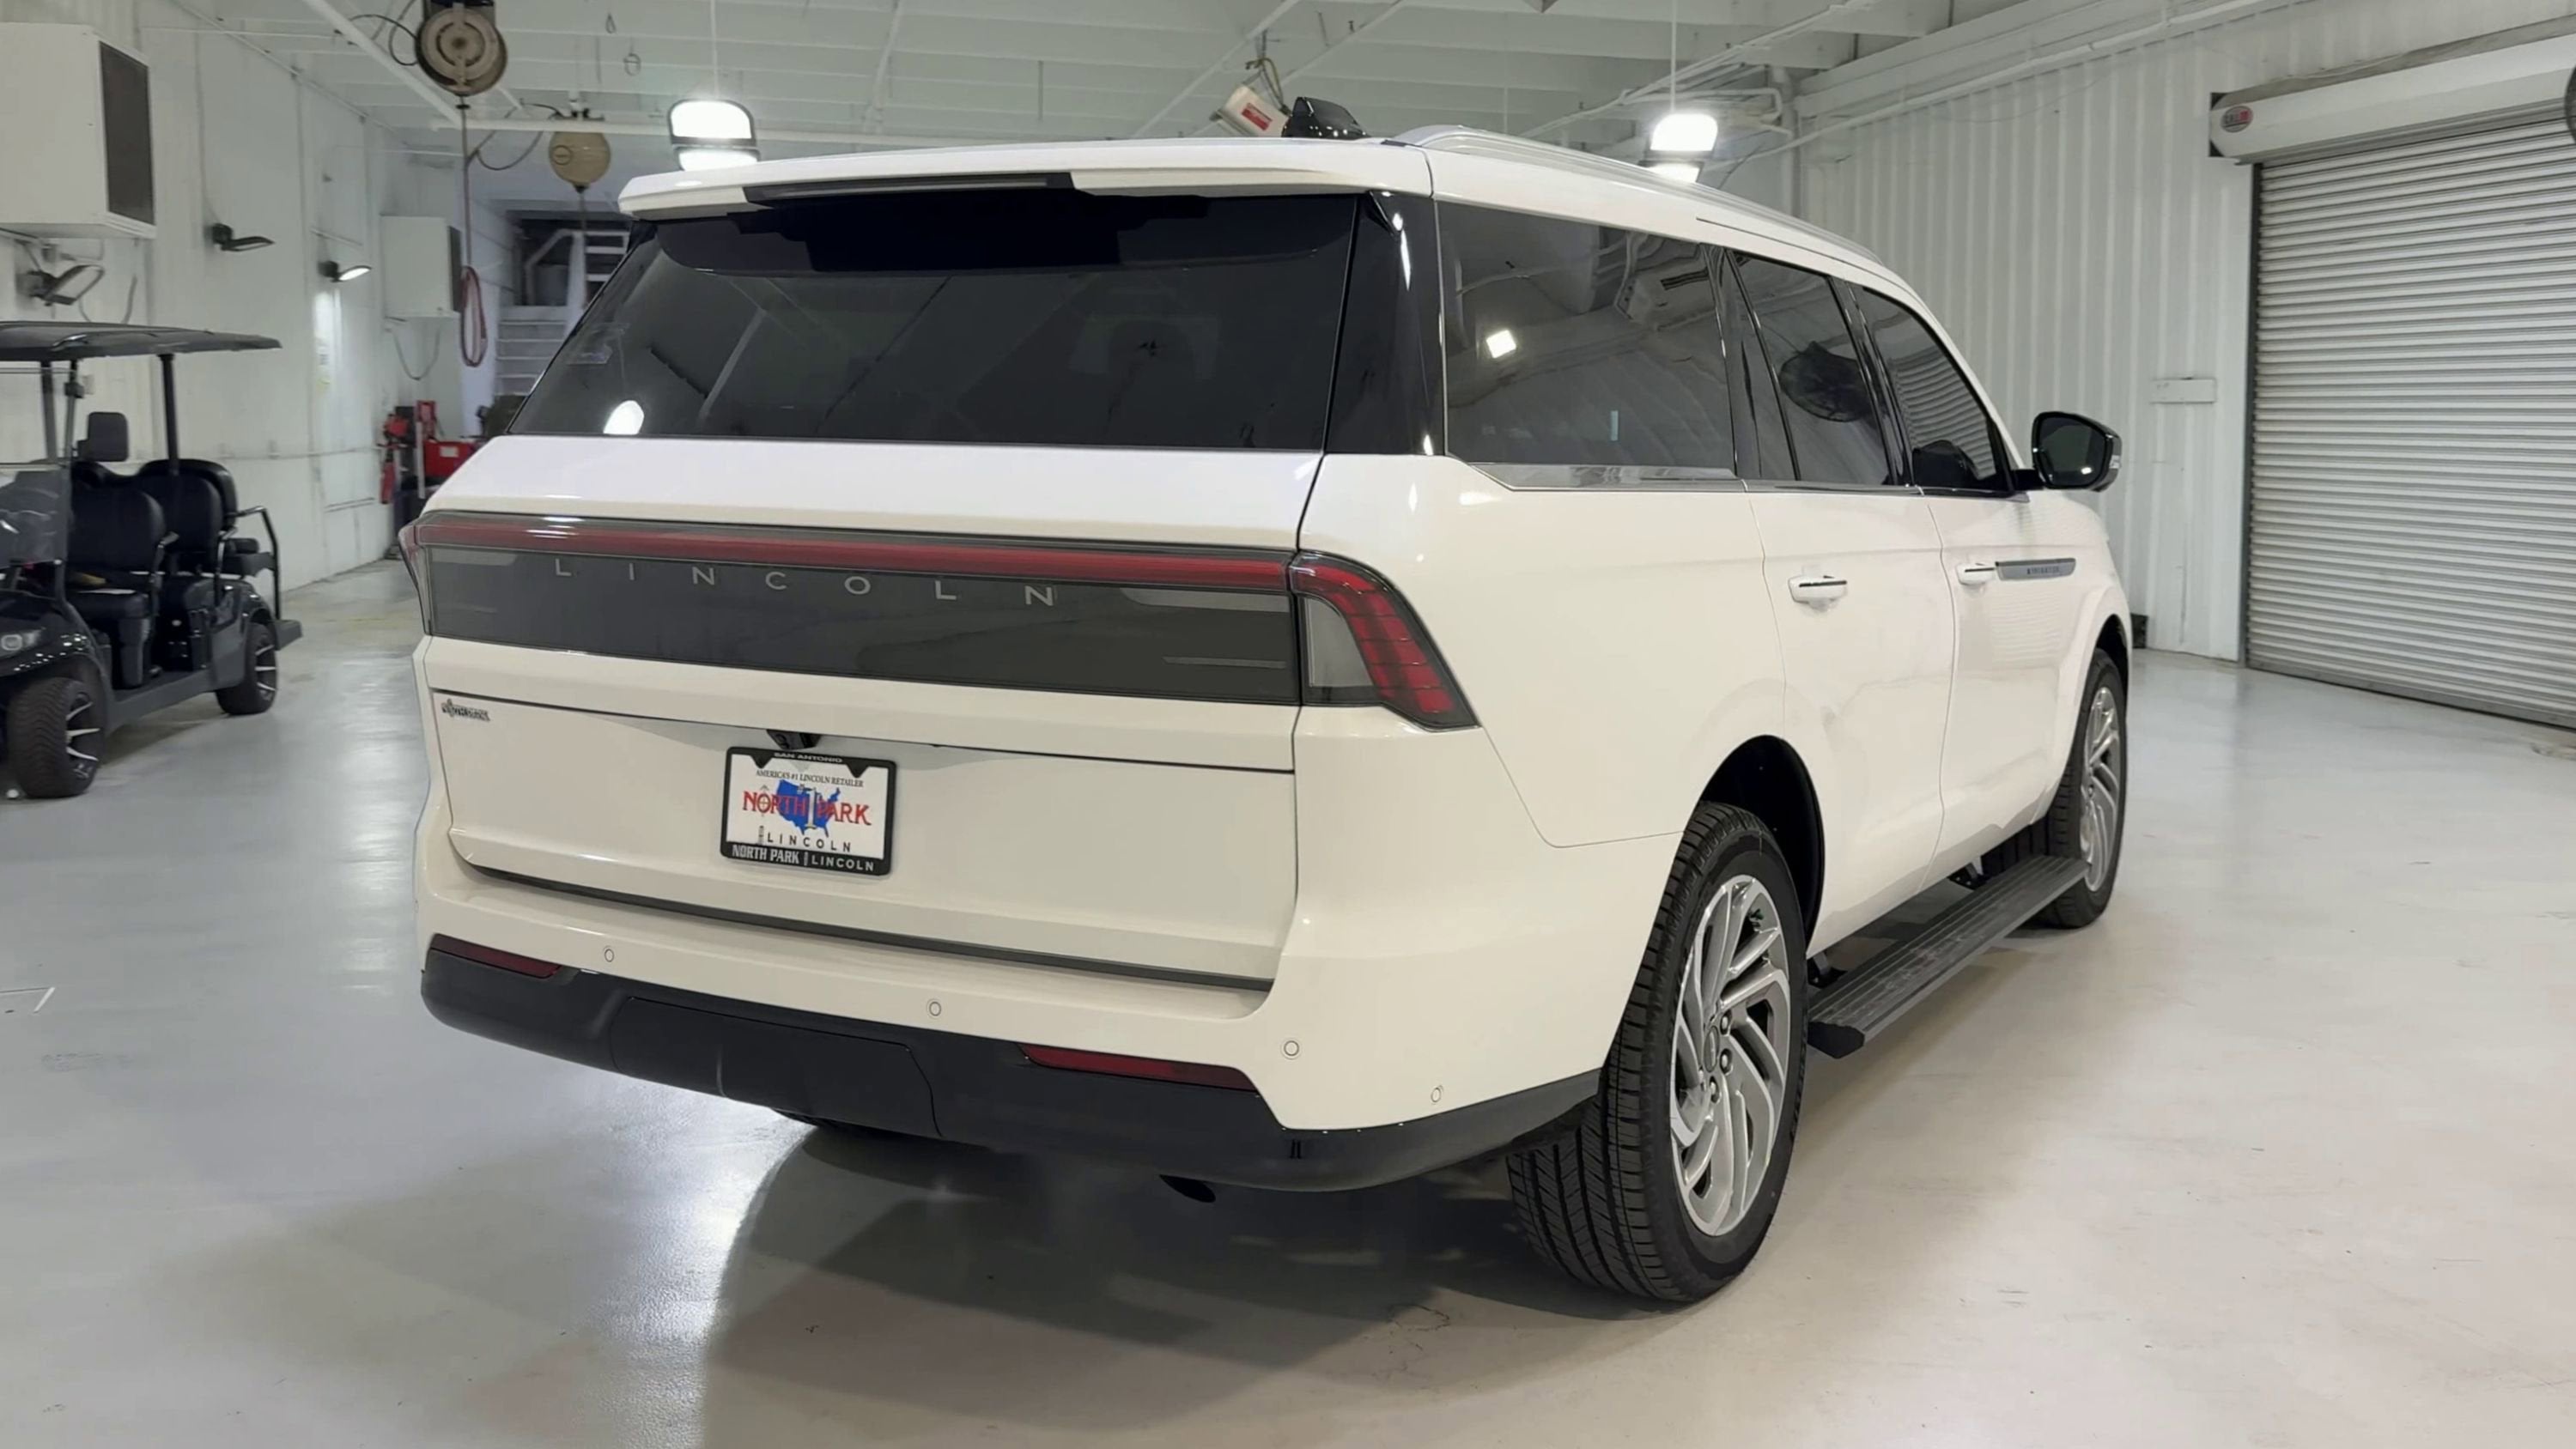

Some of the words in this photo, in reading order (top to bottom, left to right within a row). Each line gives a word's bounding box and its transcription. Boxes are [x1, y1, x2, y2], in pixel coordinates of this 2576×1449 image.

[555, 558, 1054, 607] LINCOLN
[798, 755, 843, 763] ANTONIO
[799, 773, 830, 785] LINCOLN
[831, 777, 864, 787] RETAILER
[742, 791, 807, 816] NORTH
[817, 797, 872, 826] PARK
[768, 832, 851, 852] LINCOLN
[732, 845, 767, 861] NORTH
[770, 848, 799, 864] PARK
[811, 858, 874, 871] LINCOLN
